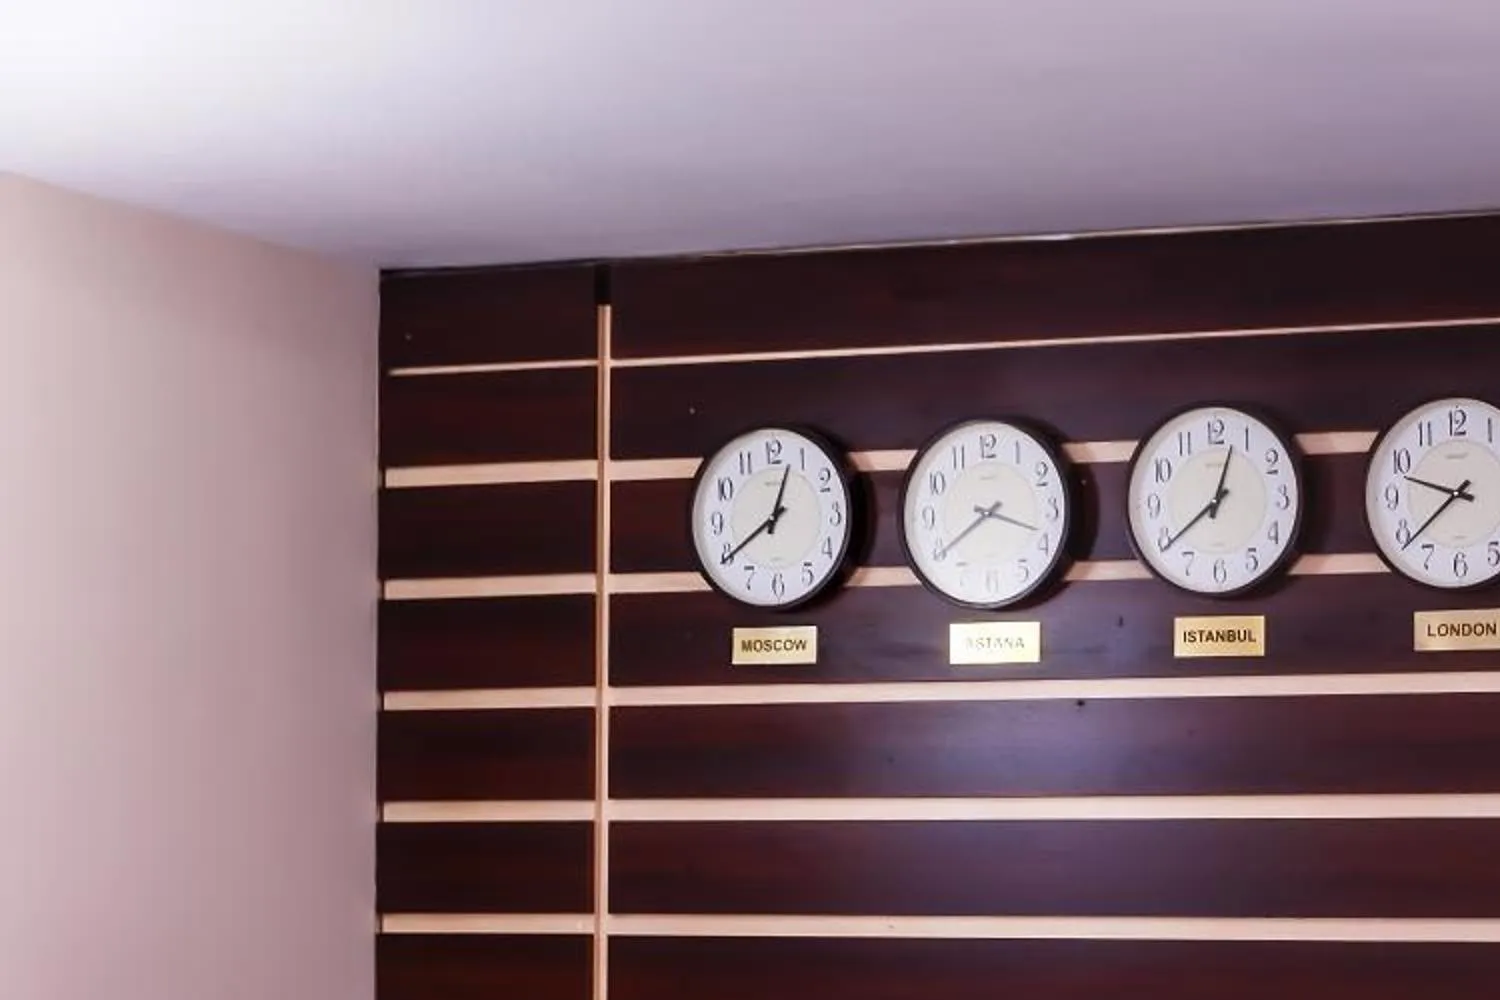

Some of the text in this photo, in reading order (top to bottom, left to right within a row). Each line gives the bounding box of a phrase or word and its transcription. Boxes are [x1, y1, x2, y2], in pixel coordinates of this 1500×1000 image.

[1207, 420, 1225, 445] 12
[1418, 420, 1432, 447] 11
[1448, 409, 1467, 437] 12
[1487, 417, 1493, 443] 1
[766, 439, 783, 464] 12
[979, 434, 997, 459] 12
[1015, 439, 1020, 465] 1
[1178, 431, 1191, 456] 11
[1244, 427, 1249, 452] 1
[739, 451, 753, 475] 11
[800, 447, 805, 471] 1
[952, 445, 965, 469] 11
[1265, 448, 1279, 475] 2
[1393, 448, 1411, 475] 10
[819, 467, 831, 493] 2
[929, 471, 946, 495] 10
[1035, 462, 1049, 486] 2
[1155, 458, 1172, 483] 10
[717, 476, 733, 502] 10
[1276, 484, 1290, 510] 3
[1385, 484, 1399, 511] 9
[829, 502, 842, 527] 3
[922, 505, 935, 530] 9
[1046, 498, 1059, 521] 3
[1147, 493, 1161, 518] 9
[711, 511, 724, 535] 9
[1268, 521, 1279, 545] 4
[822, 536, 833, 560] 4
[1037, 534, 1049, 557] 4
[1421, 543, 1435, 571] 7
[1487, 541, 1500, 566] 5
[1017, 559, 1029, 582] 5
[1182, 552, 1195, 577] 7
[1213, 559, 1227, 583] 6
[1246, 548, 1258, 572] 5
[1453, 552, 1468, 578] 6
[743, 565, 755, 591] 7
[771, 573, 785, 598] 6
[802, 562, 815, 586] 5
[1183, 629, 1257, 643] ISTANBUL
[1427, 622, 1497, 637] LONDON
[741, 639, 807, 653] MOSCOW
